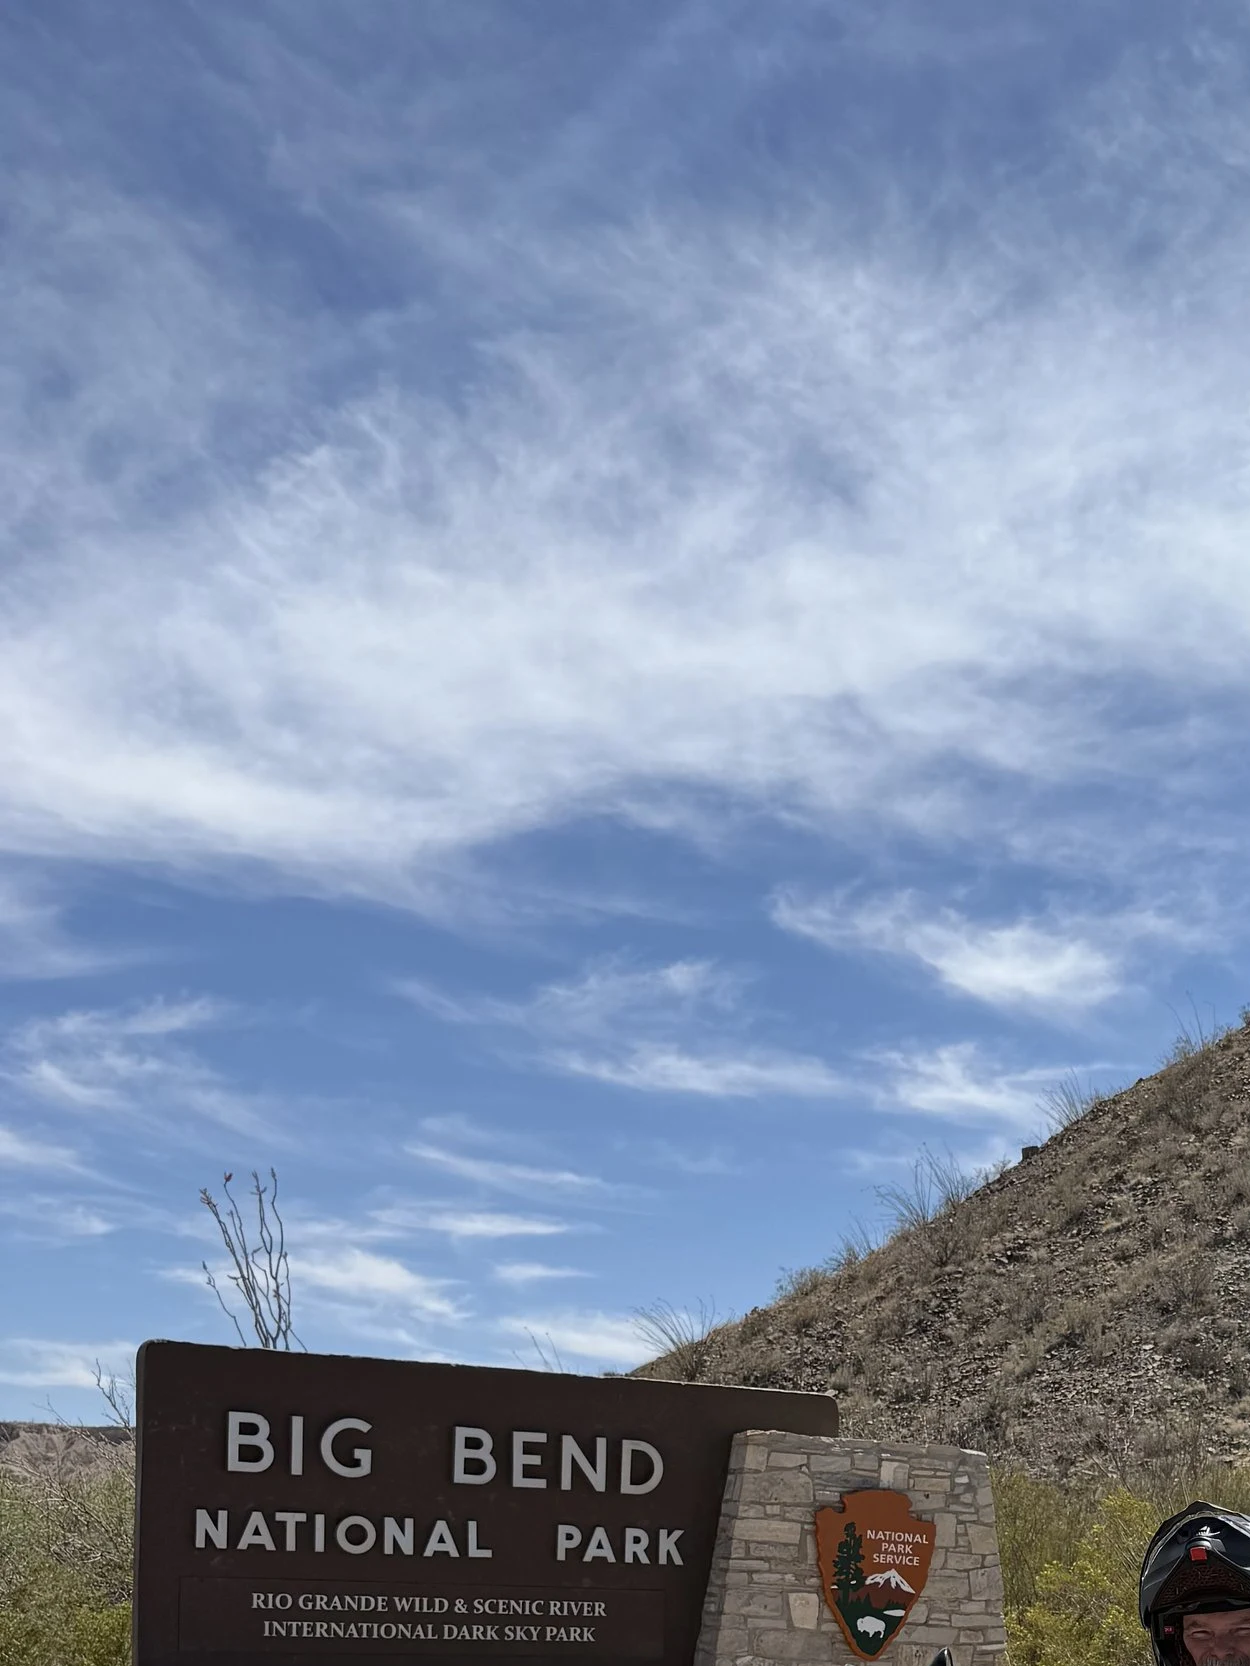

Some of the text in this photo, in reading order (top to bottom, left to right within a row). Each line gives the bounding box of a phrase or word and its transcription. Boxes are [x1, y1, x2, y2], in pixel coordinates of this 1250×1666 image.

[227, 1410, 664, 1495] BIG BEND
[195, 1508, 685, 1566] NATIONAL PARK
[866, 1529, 929, 1544] NATIONAL
[881, 1542, 913, 1554] PARK
[873, 1553, 920, 1566] SERVICE
[251, 1593, 607, 1617] RIO GRANDE WILD & SCENIC RIVER
[263, 1620, 596, 1642] INTERNATIONAL DARK SKY PARK
